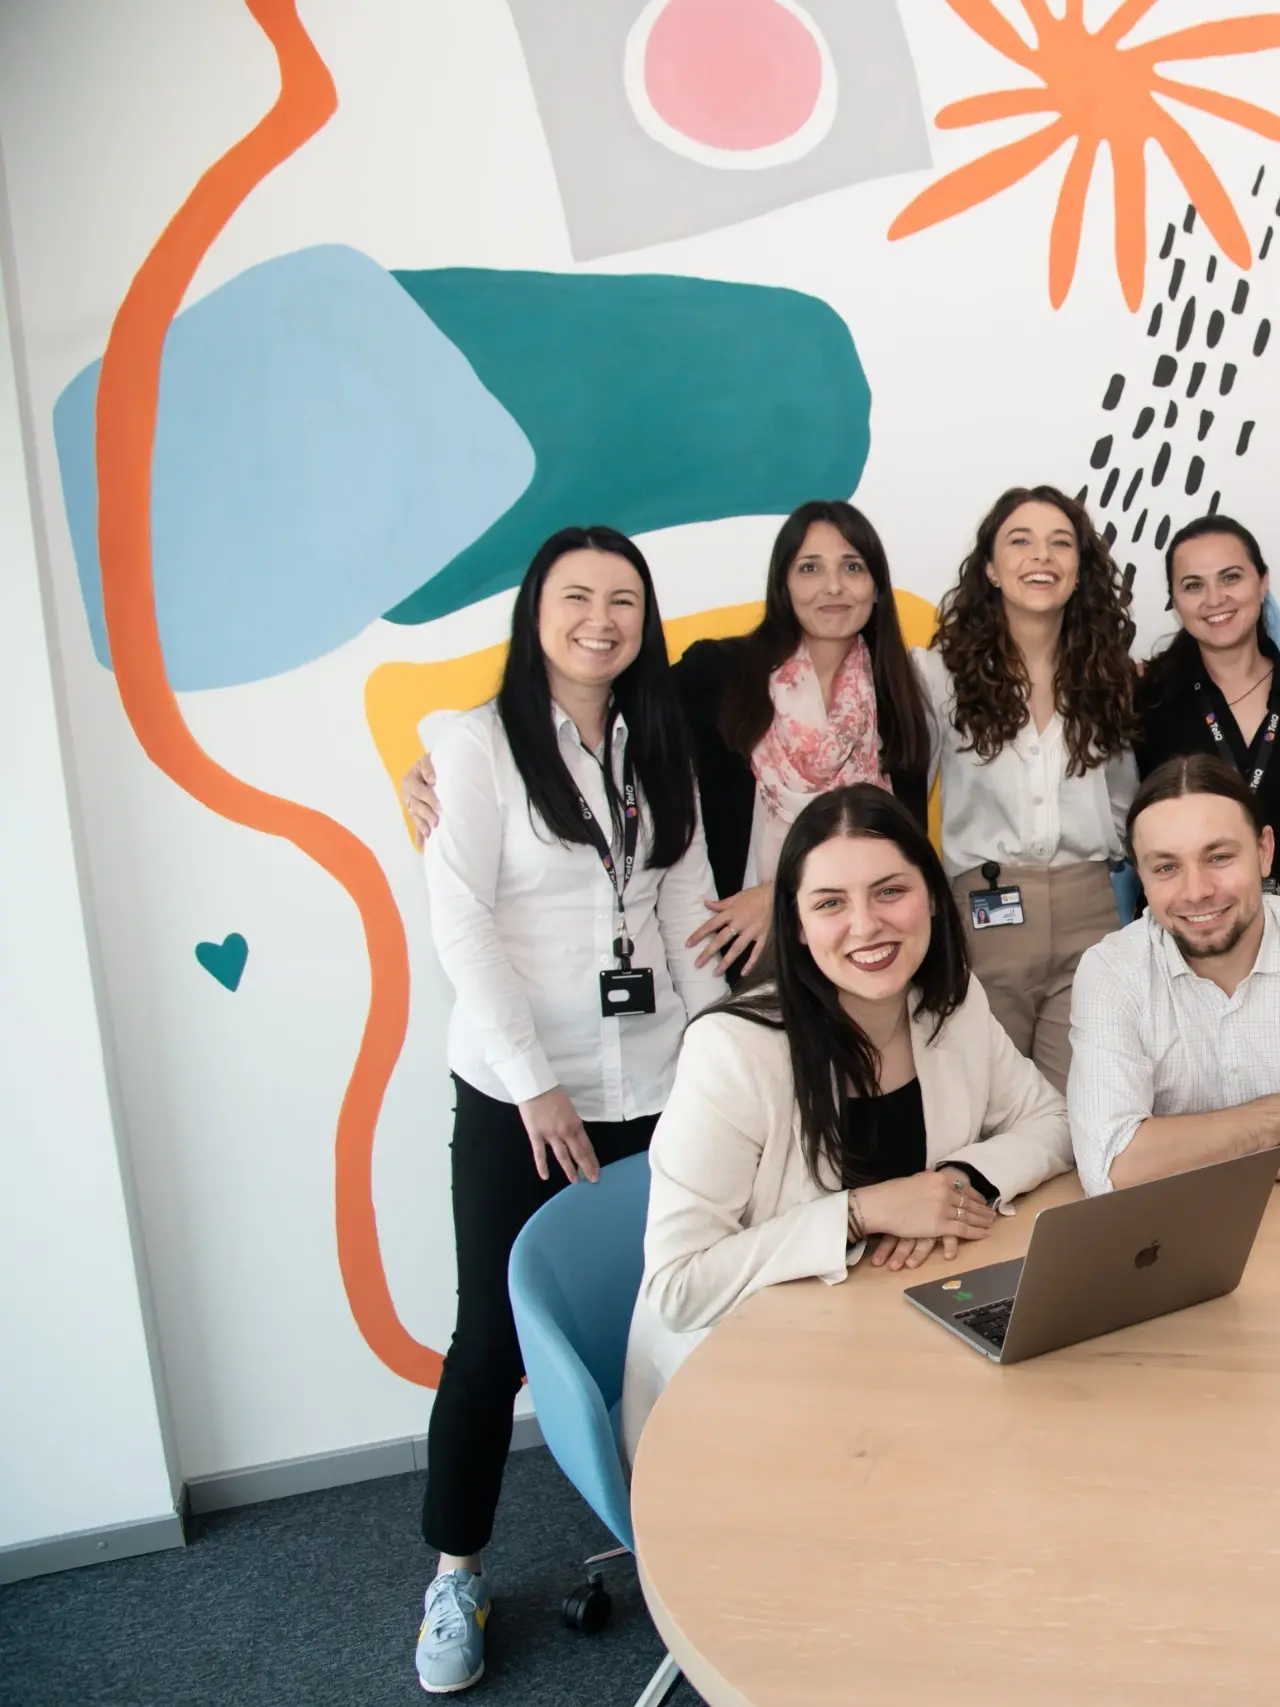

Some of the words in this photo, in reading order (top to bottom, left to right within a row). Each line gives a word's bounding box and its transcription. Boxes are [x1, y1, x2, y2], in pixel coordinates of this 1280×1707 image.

[1210, 722, 1223, 741] TelQ
[1268, 713, 1280, 732] TelQ
[1250, 768, 1264, 789] TelQ
